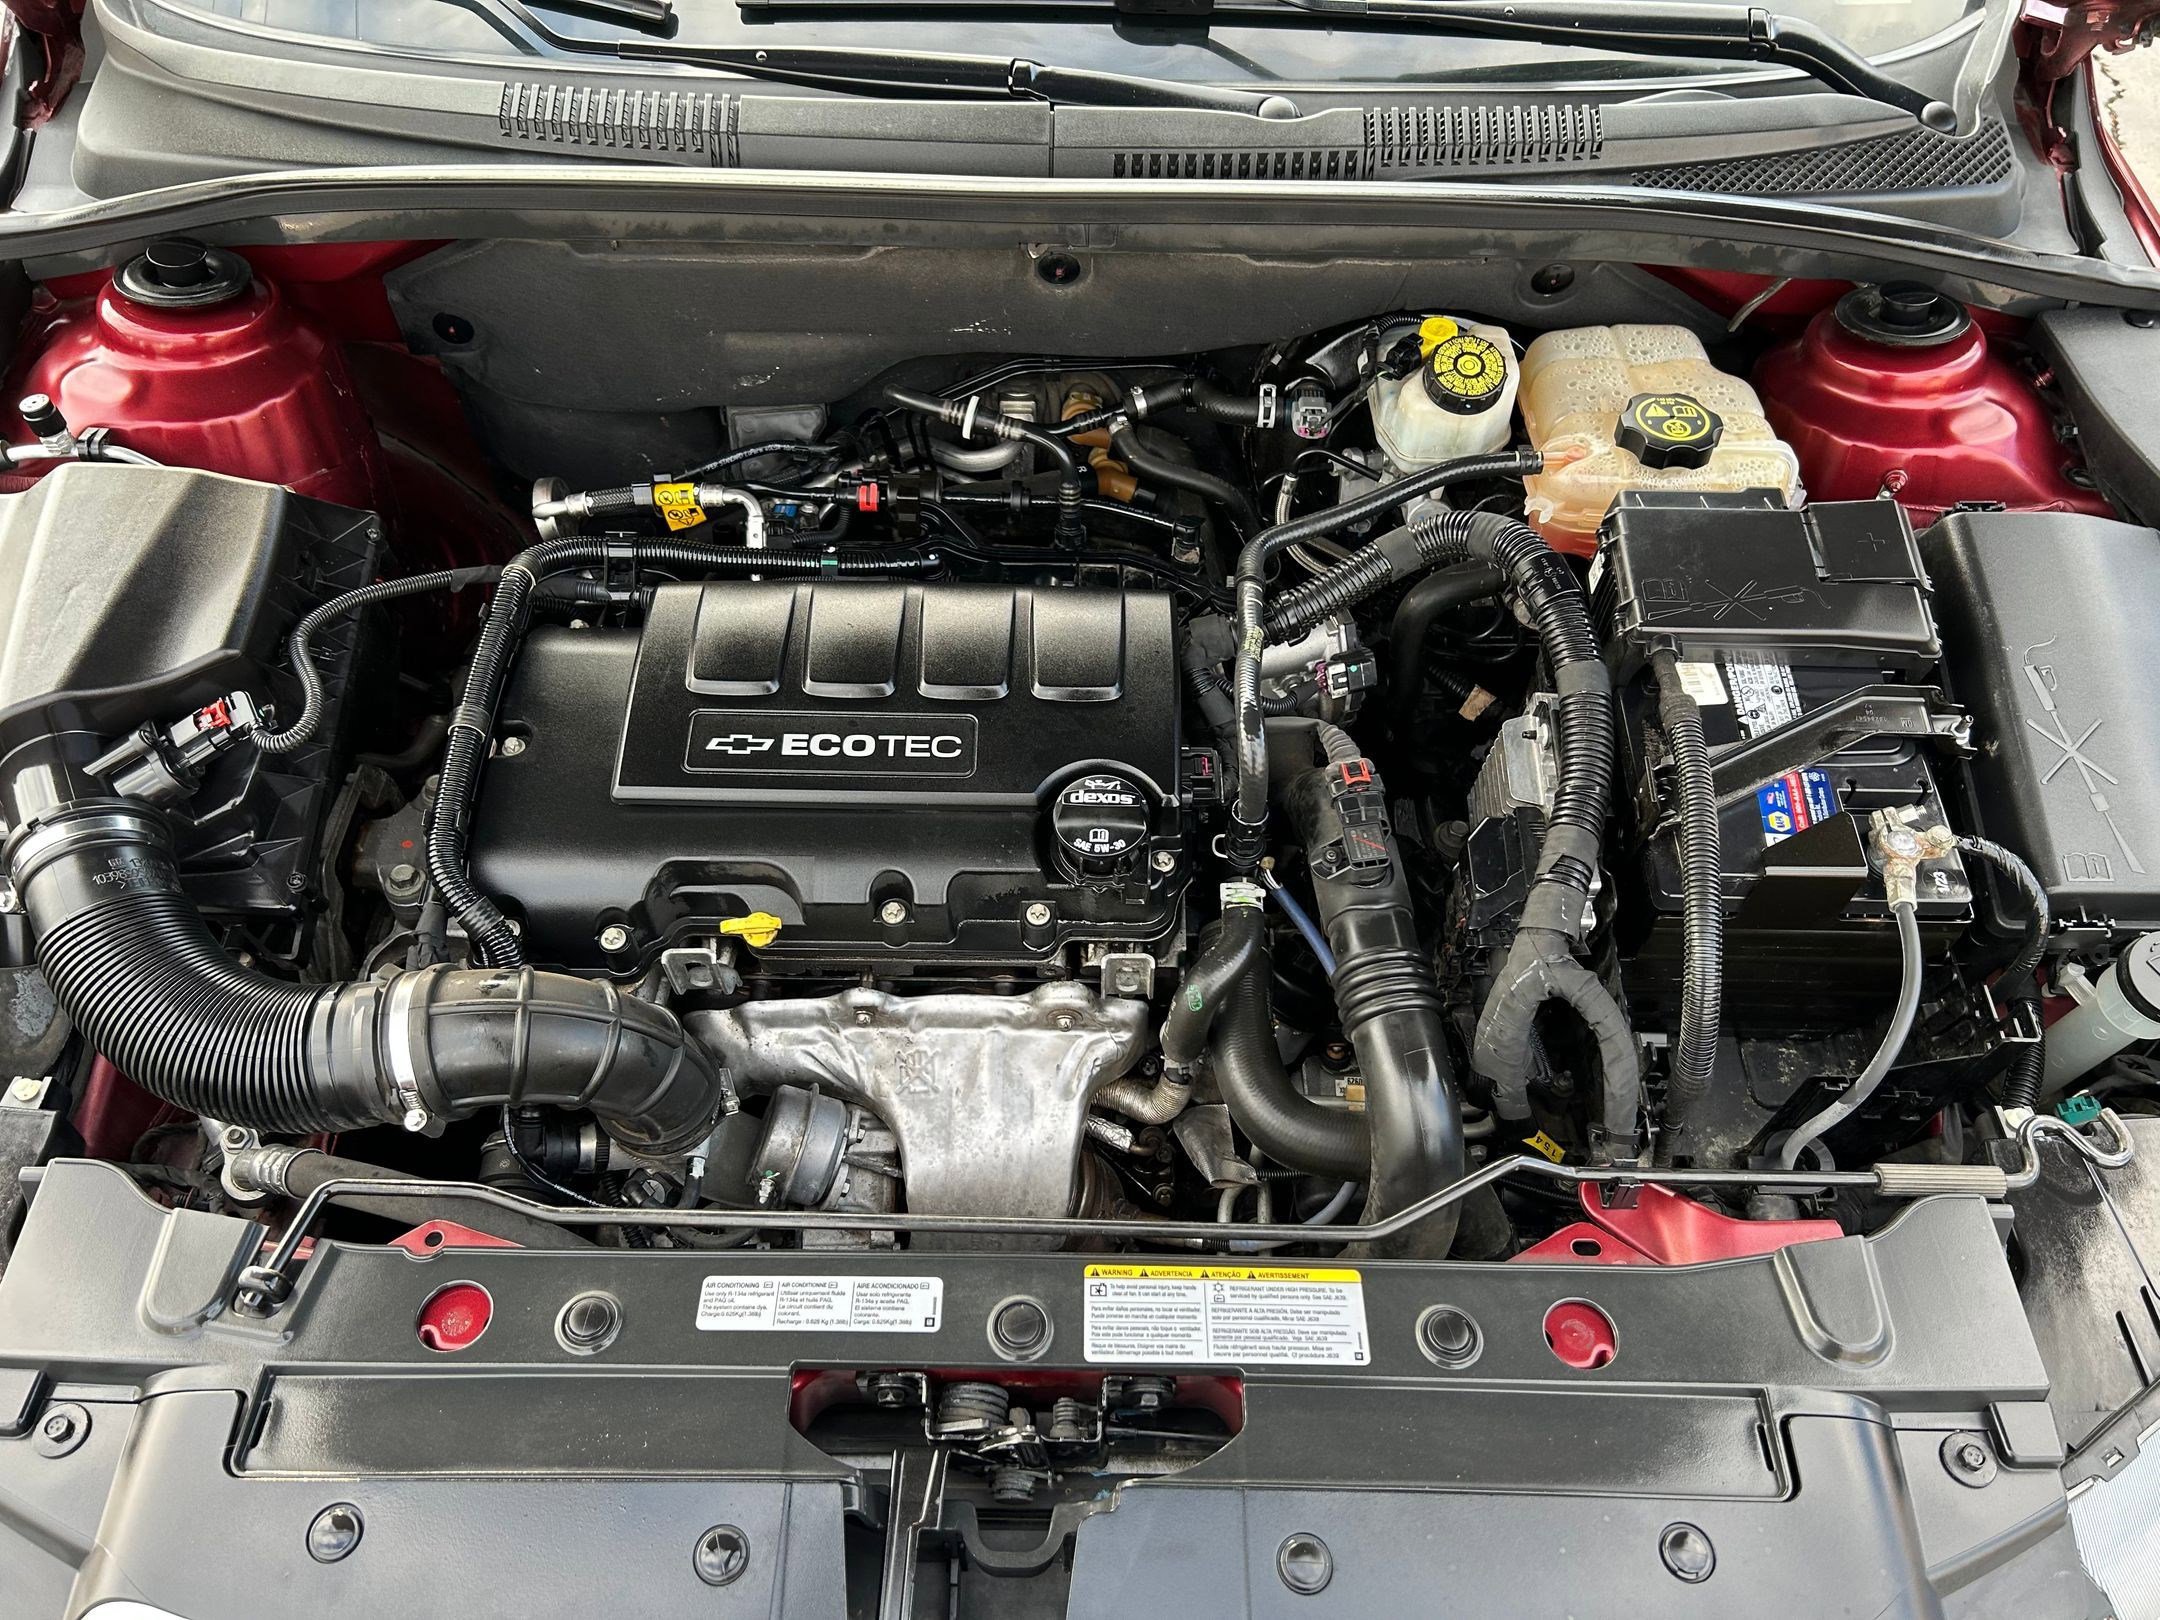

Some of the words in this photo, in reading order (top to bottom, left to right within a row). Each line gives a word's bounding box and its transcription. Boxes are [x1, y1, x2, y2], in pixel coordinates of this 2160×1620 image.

[781, 733, 962, 758] ECOTEC
[1069, 789, 1136, 805] dexos
[1073, 838, 1092, 852] SAE
[1094, 839, 1126, 853] 5W-30
[1211, 1270, 1241, 1278] ATENÇÃO
